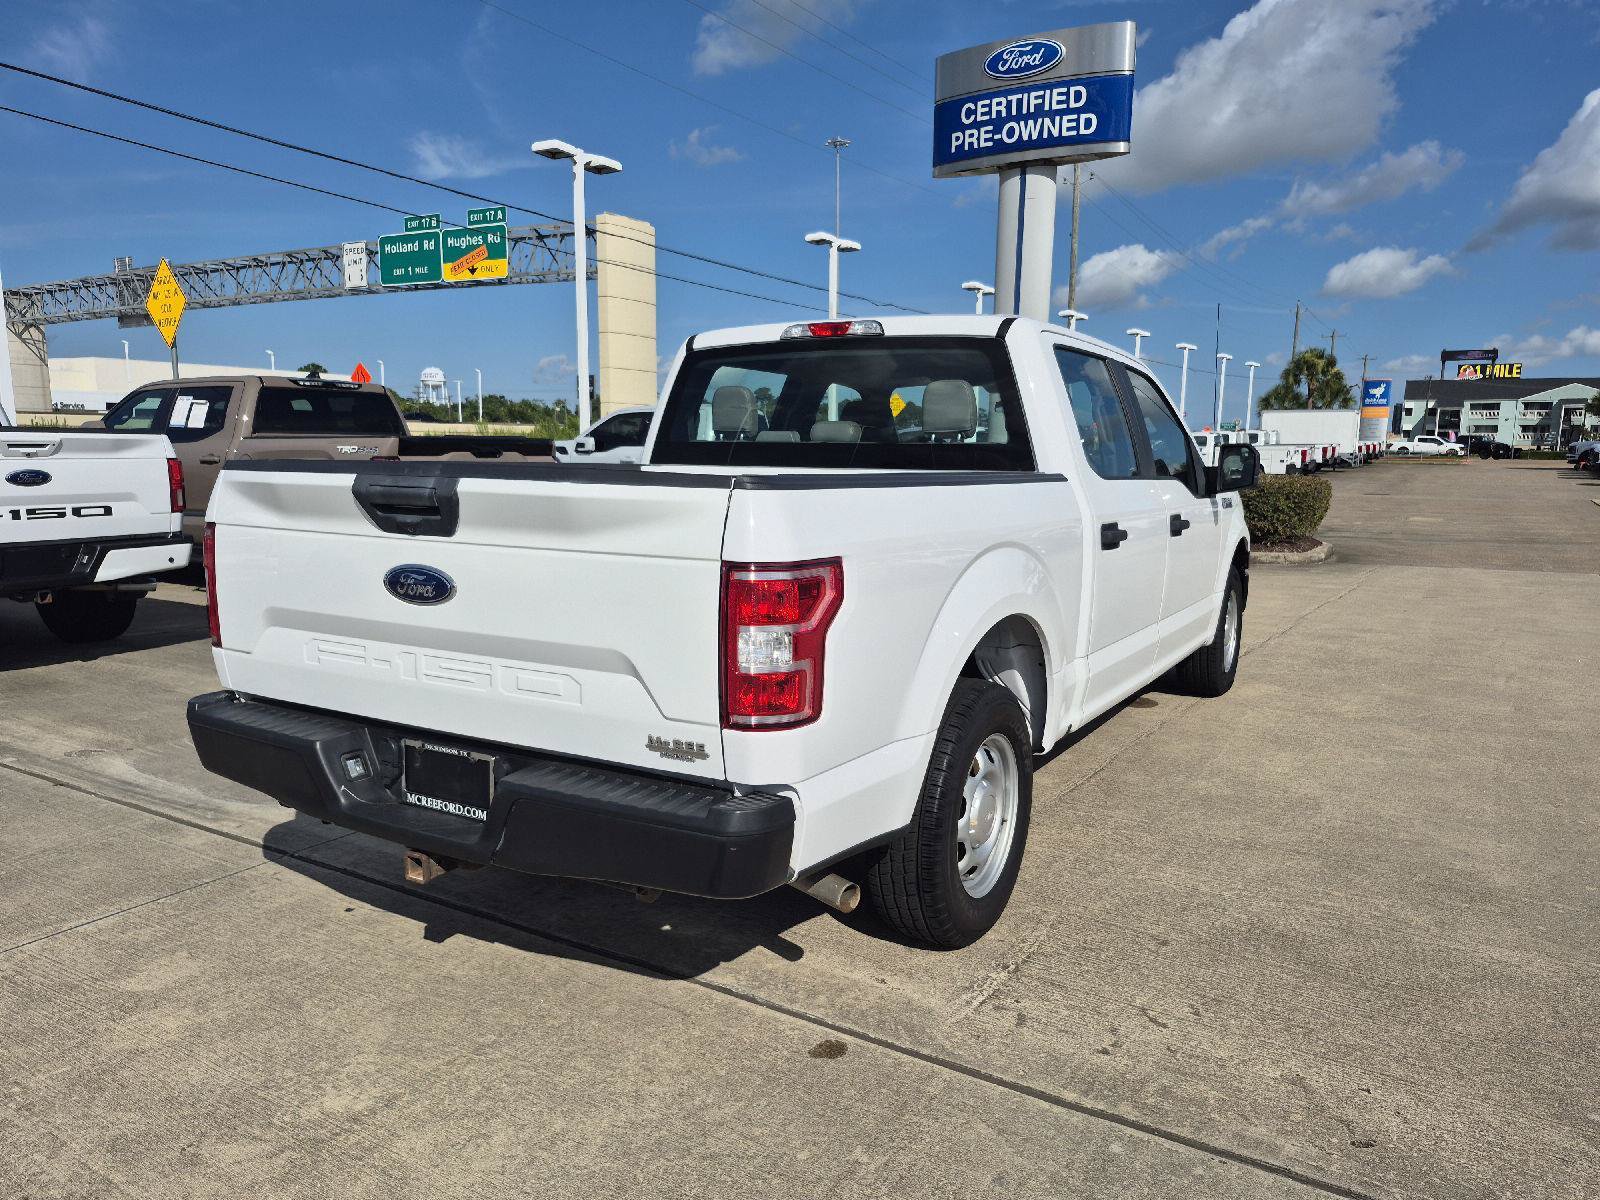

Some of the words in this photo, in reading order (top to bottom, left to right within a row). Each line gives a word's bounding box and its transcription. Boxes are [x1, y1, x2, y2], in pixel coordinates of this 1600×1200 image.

[997, 44, 1043, 71] Ford
[960, 85, 1087, 125] CERTIFIED
[951, 113, 1098, 153] PRE-OWNED
[407, 220, 419, 229] EXIT
[422, 217, 430, 228] 17
[470, 213, 483, 221] EXIT
[486, 210, 495, 220] 17
[497, 209, 503, 220] A
[384, 240, 419, 254] Holland
[423, 238, 435, 251] Rd
[447, 234, 483, 249] Hughes
[487, 231, 501, 244] Rd
[344, 247, 365, 256] SPEED
[393, 268, 405, 276] EXIT
[407, 266, 412, 276] 1
[414, 266, 429, 274] MILE
[336, 445, 358, 454] TRD
[0, 505, 113, 521] 150
[396, 572, 436, 598] Ford
[304, 638, 583, 705] F-150
[406, 793, 487, 821] MCREEFORD.COM
